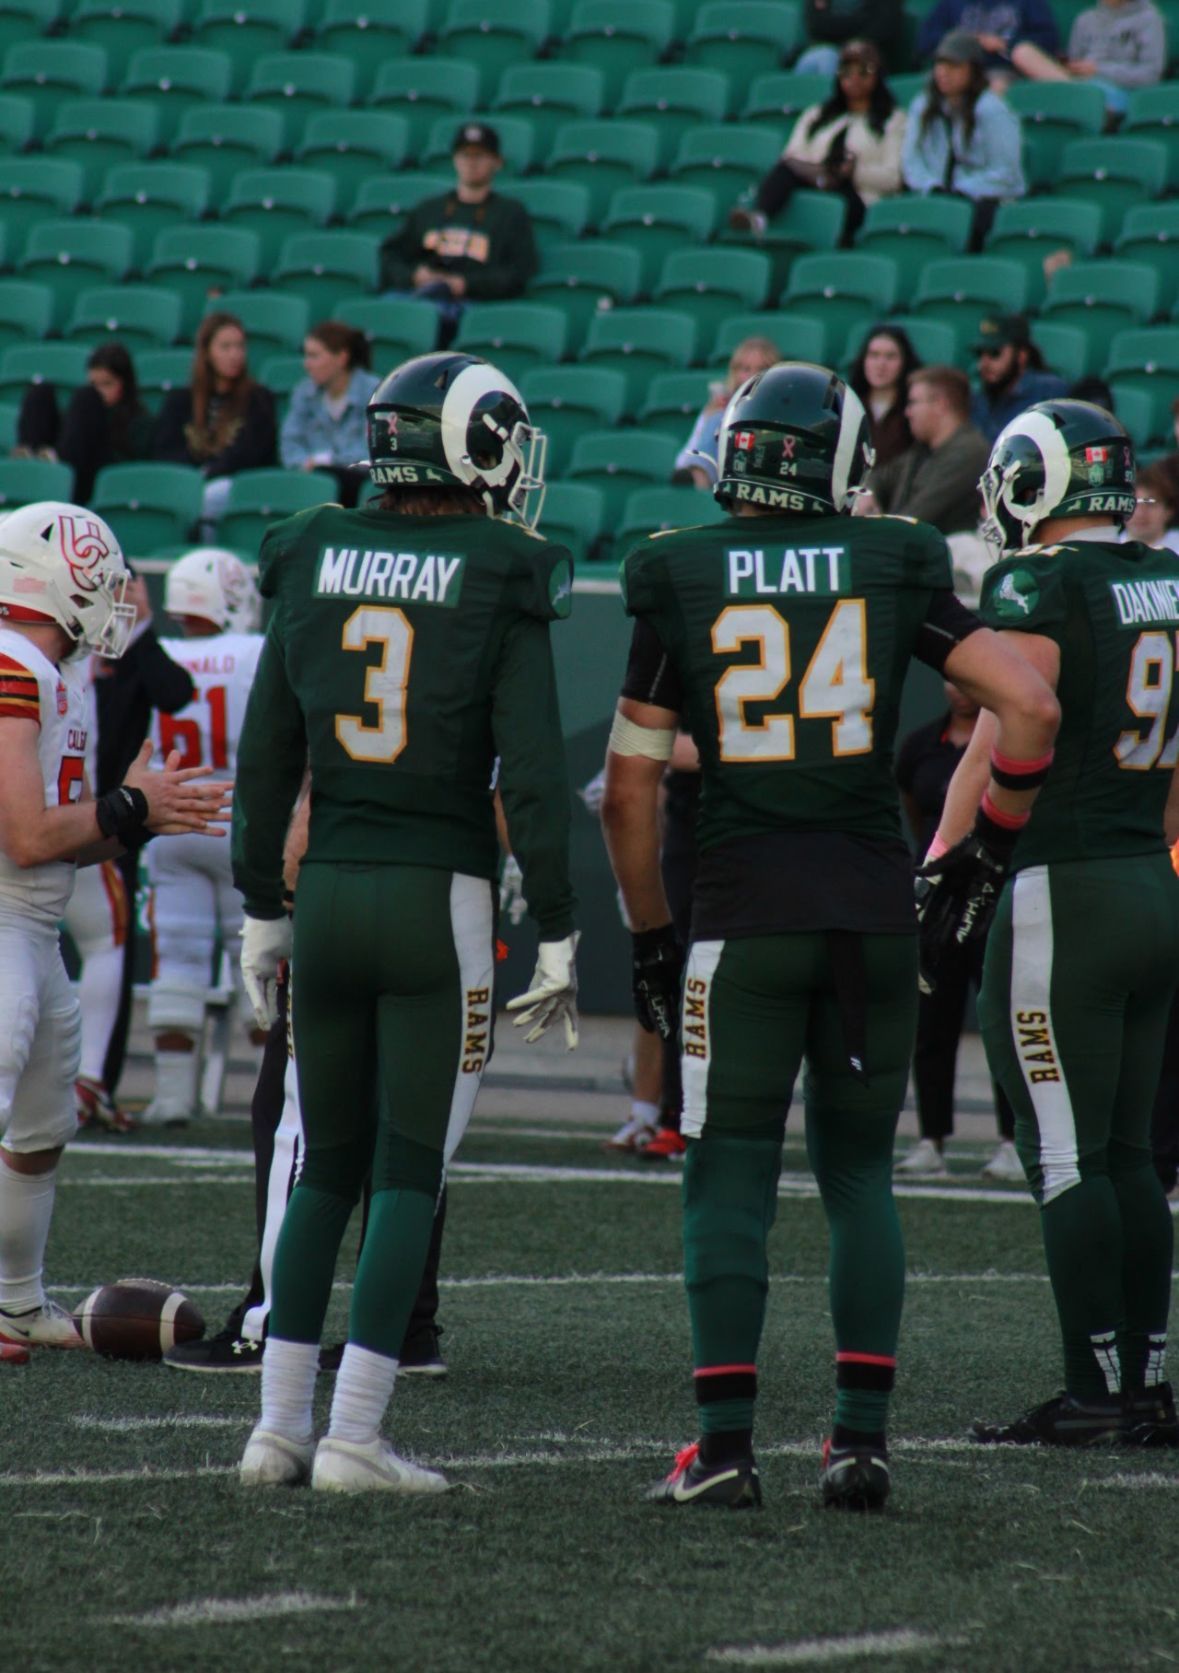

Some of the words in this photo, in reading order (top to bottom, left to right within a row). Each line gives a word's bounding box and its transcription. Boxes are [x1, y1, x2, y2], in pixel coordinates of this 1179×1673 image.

[389, 437, 398, 451] 3
[779, 461, 797, 476] 24
[369, 466, 419, 483] RAMS
[736, 483, 805, 511] RAMS
[1087, 495, 1135, 513] RAMS
[317, 548, 461, 603] MURRAY
[728, 547, 844, 594] PLATT
[335, 604, 415, 764] 3
[711, 598, 876, 762] 24
[461, 986, 490, 1074] RAMS
[684, 978, 707, 1061] RAMS
[1016, 1011, 1061, 1084] RAMS
